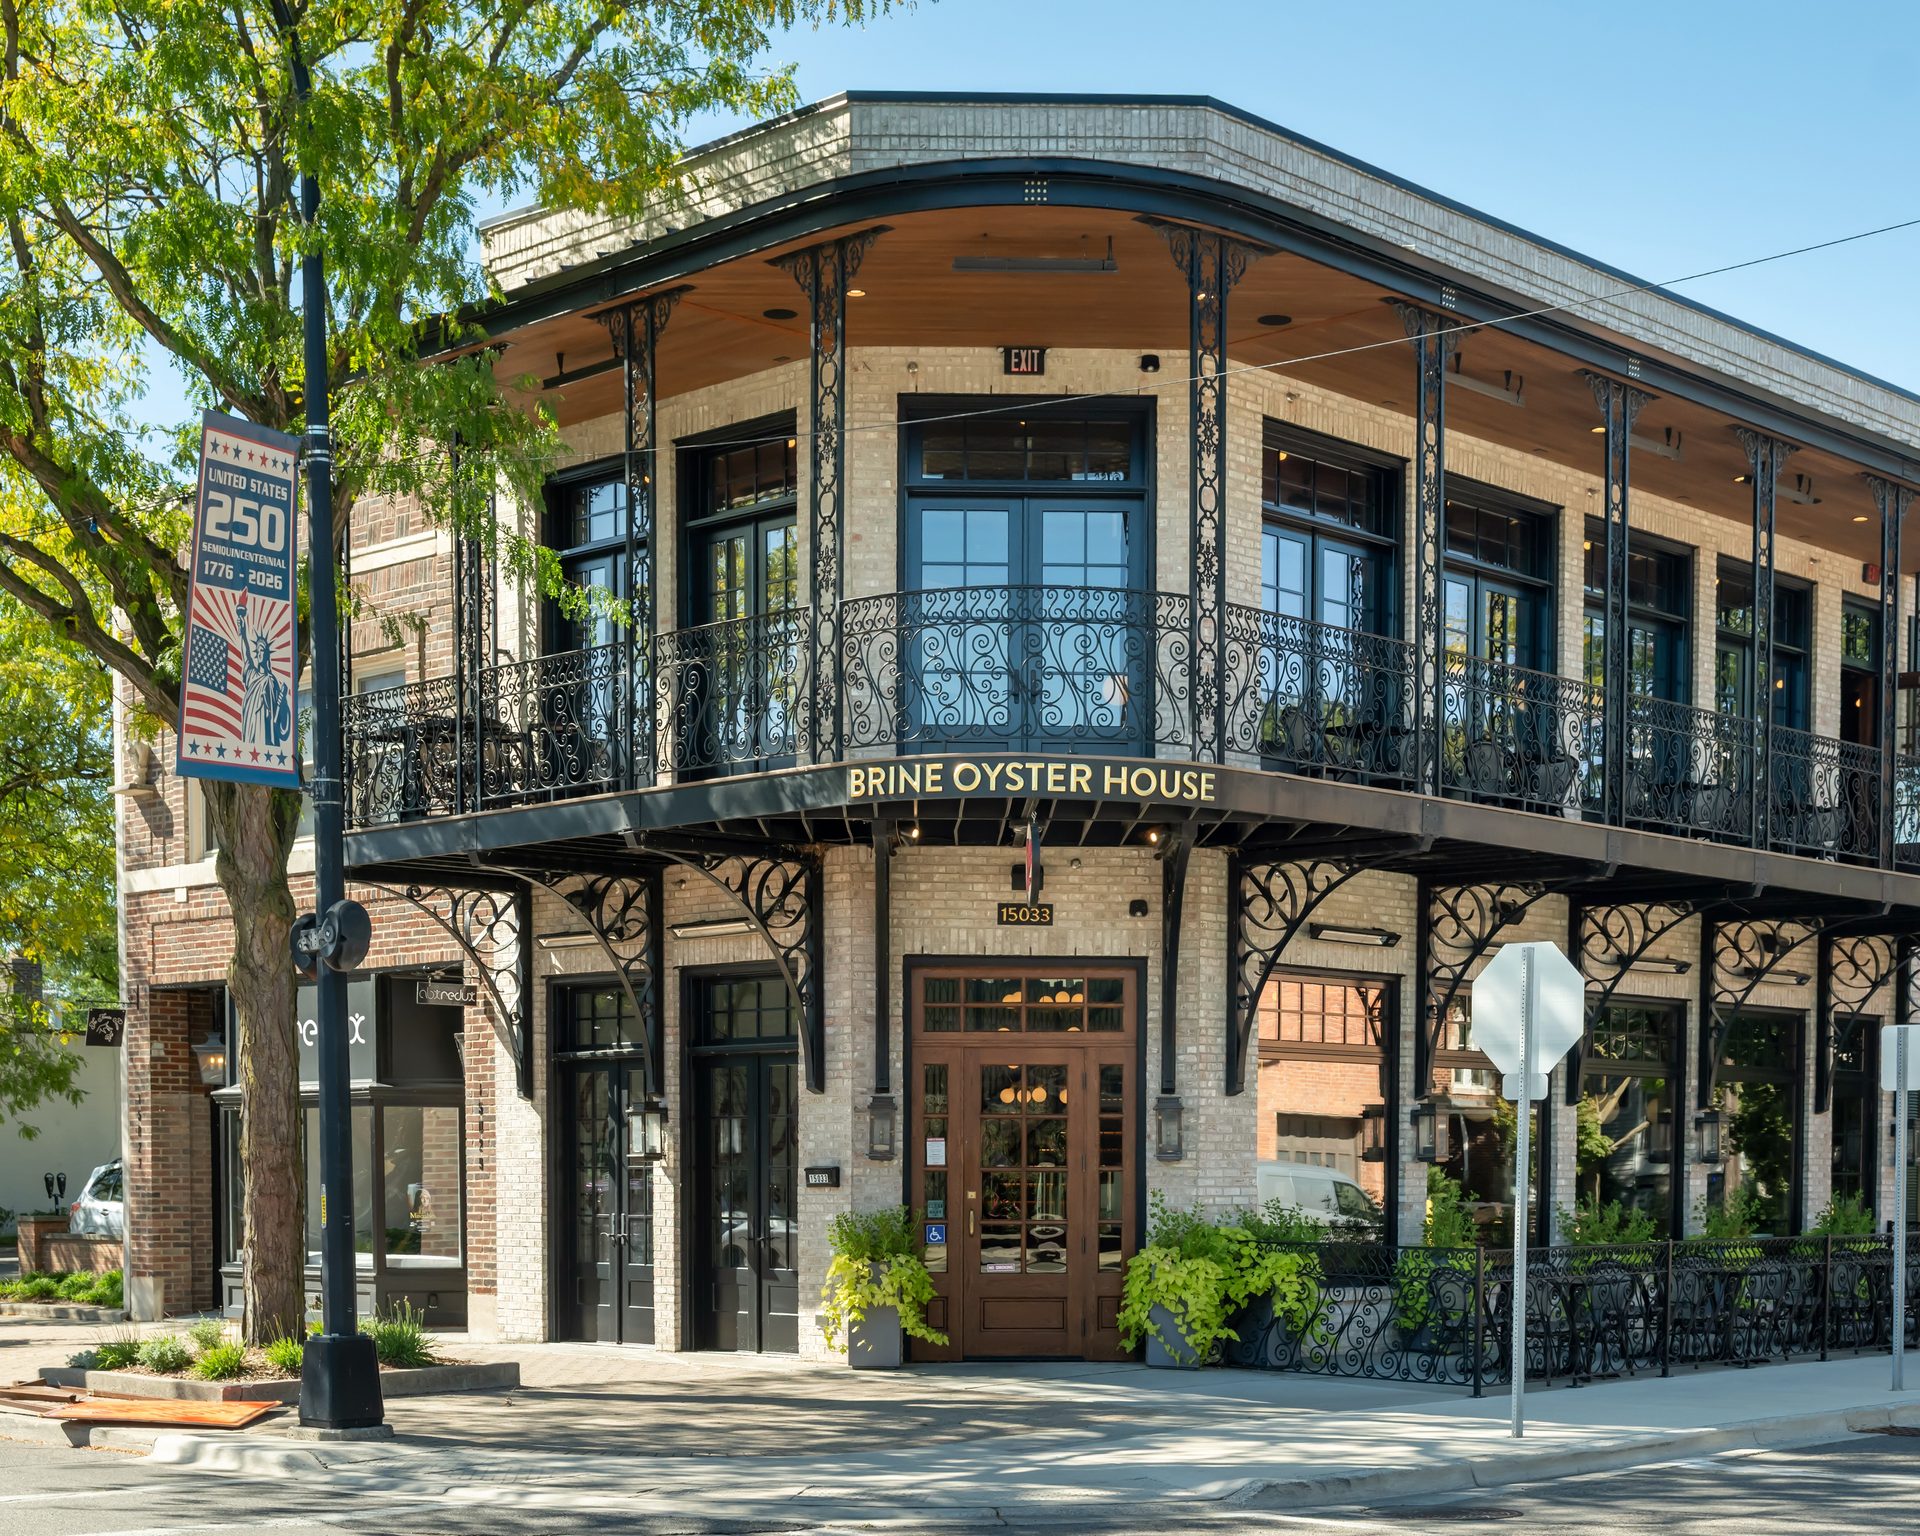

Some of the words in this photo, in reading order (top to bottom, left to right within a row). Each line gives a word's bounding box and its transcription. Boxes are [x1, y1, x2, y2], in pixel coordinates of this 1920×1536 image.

[1011, 349, 1040, 372] EXIT
[208, 467, 247, 490] UNITED
[250, 478, 288, 501] STATES
[205, 490, 285, 552] 250
[202, 541, 287, 569] SEMIQUINCENTENNIAL
[204, 560, 234, 580] 1776
[248, 569, 283, 590] 2026
[850, 763, 944, 798] BRINE
[953, 762, 1093, 792] OYSTER
[1103, 765, 1216, 802] HOUSE
[1001, 907, 1050, 922] 15033
